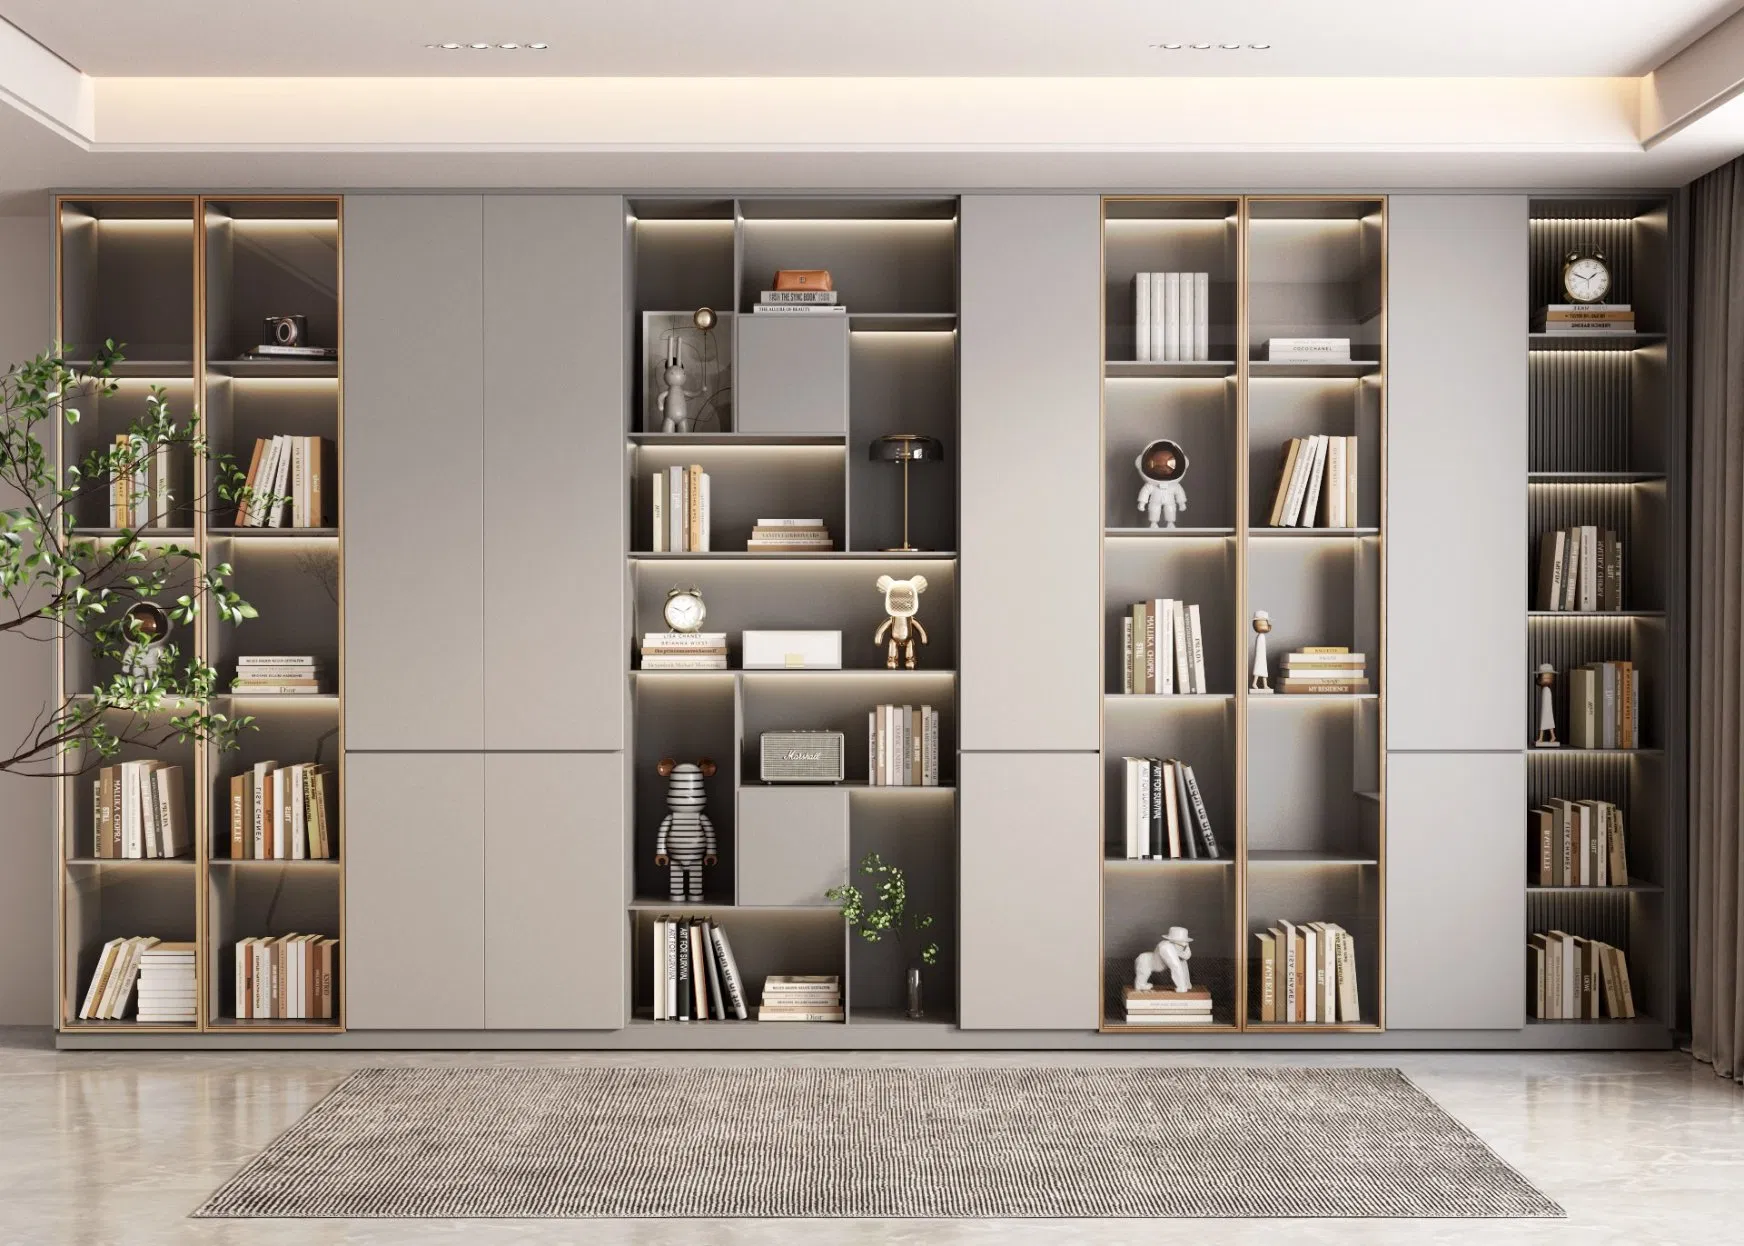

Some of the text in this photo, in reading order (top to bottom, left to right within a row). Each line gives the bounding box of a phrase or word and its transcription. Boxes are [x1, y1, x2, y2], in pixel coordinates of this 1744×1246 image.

[803, 293, 816, 301] BOOK
[782, 750, 822, 761] Marshall
[1153, 766, 1161, 819] ART FOR SURVIVAL
[1188, 779, 1203, 806] urban
[1198, 808, 1207, 819] an
[1205, 834, 1215, 847] art
[668, 928, 676, 980] ART FOR SURVIVAL
[680, 928, 688, 981] ART FOR SURVIVAL
[715, 940, 728, 968] urban
[725, 970, 733, 983] an
[1583, 974, 1591, 992] LOEWE
[731, 995, 742, 1008] art
